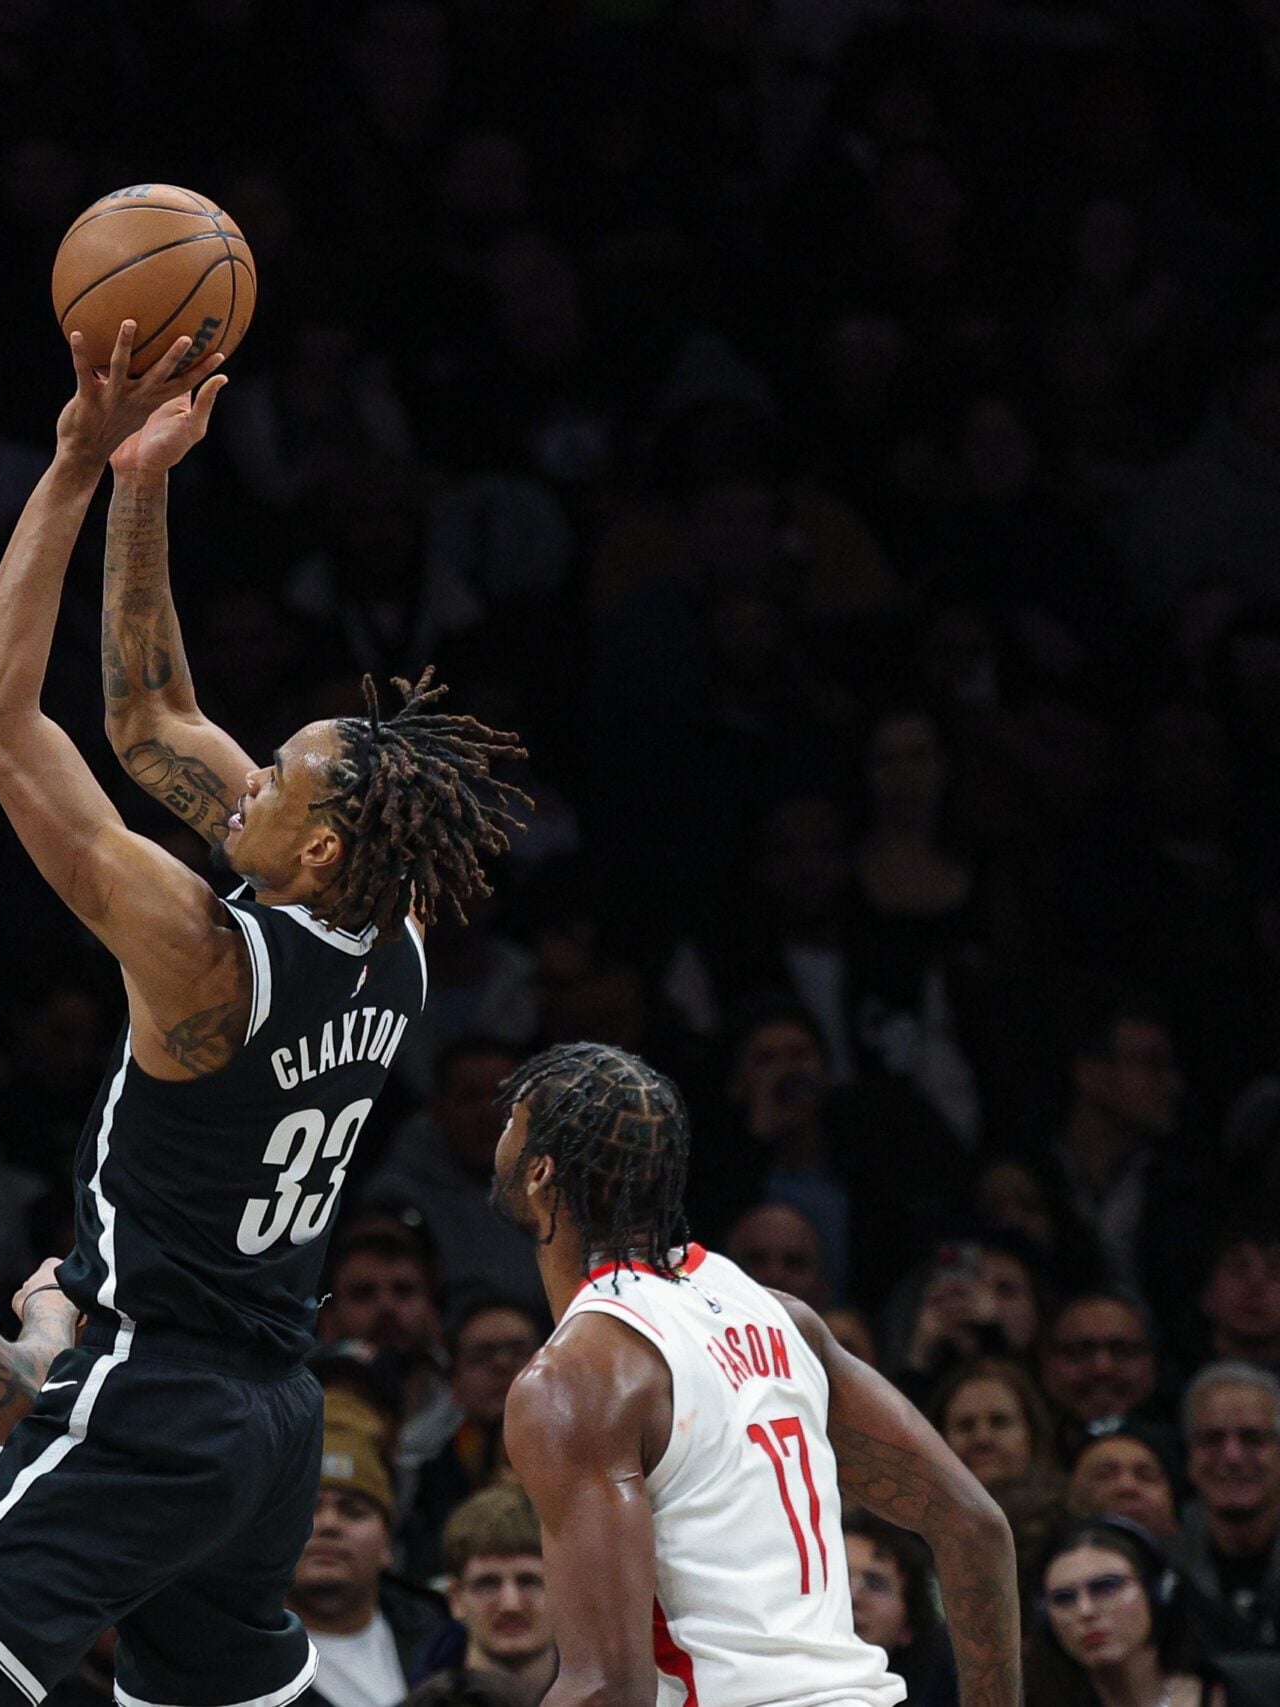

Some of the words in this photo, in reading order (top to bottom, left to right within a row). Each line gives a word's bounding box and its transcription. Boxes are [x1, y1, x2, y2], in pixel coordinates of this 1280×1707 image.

[271, 1007, 408, 1091] CLAXTON
[236, 1097, 373, 1255] 33
[706, 1323, 792, 1393] EASON
[746, 1416, 828, 1595] 17
